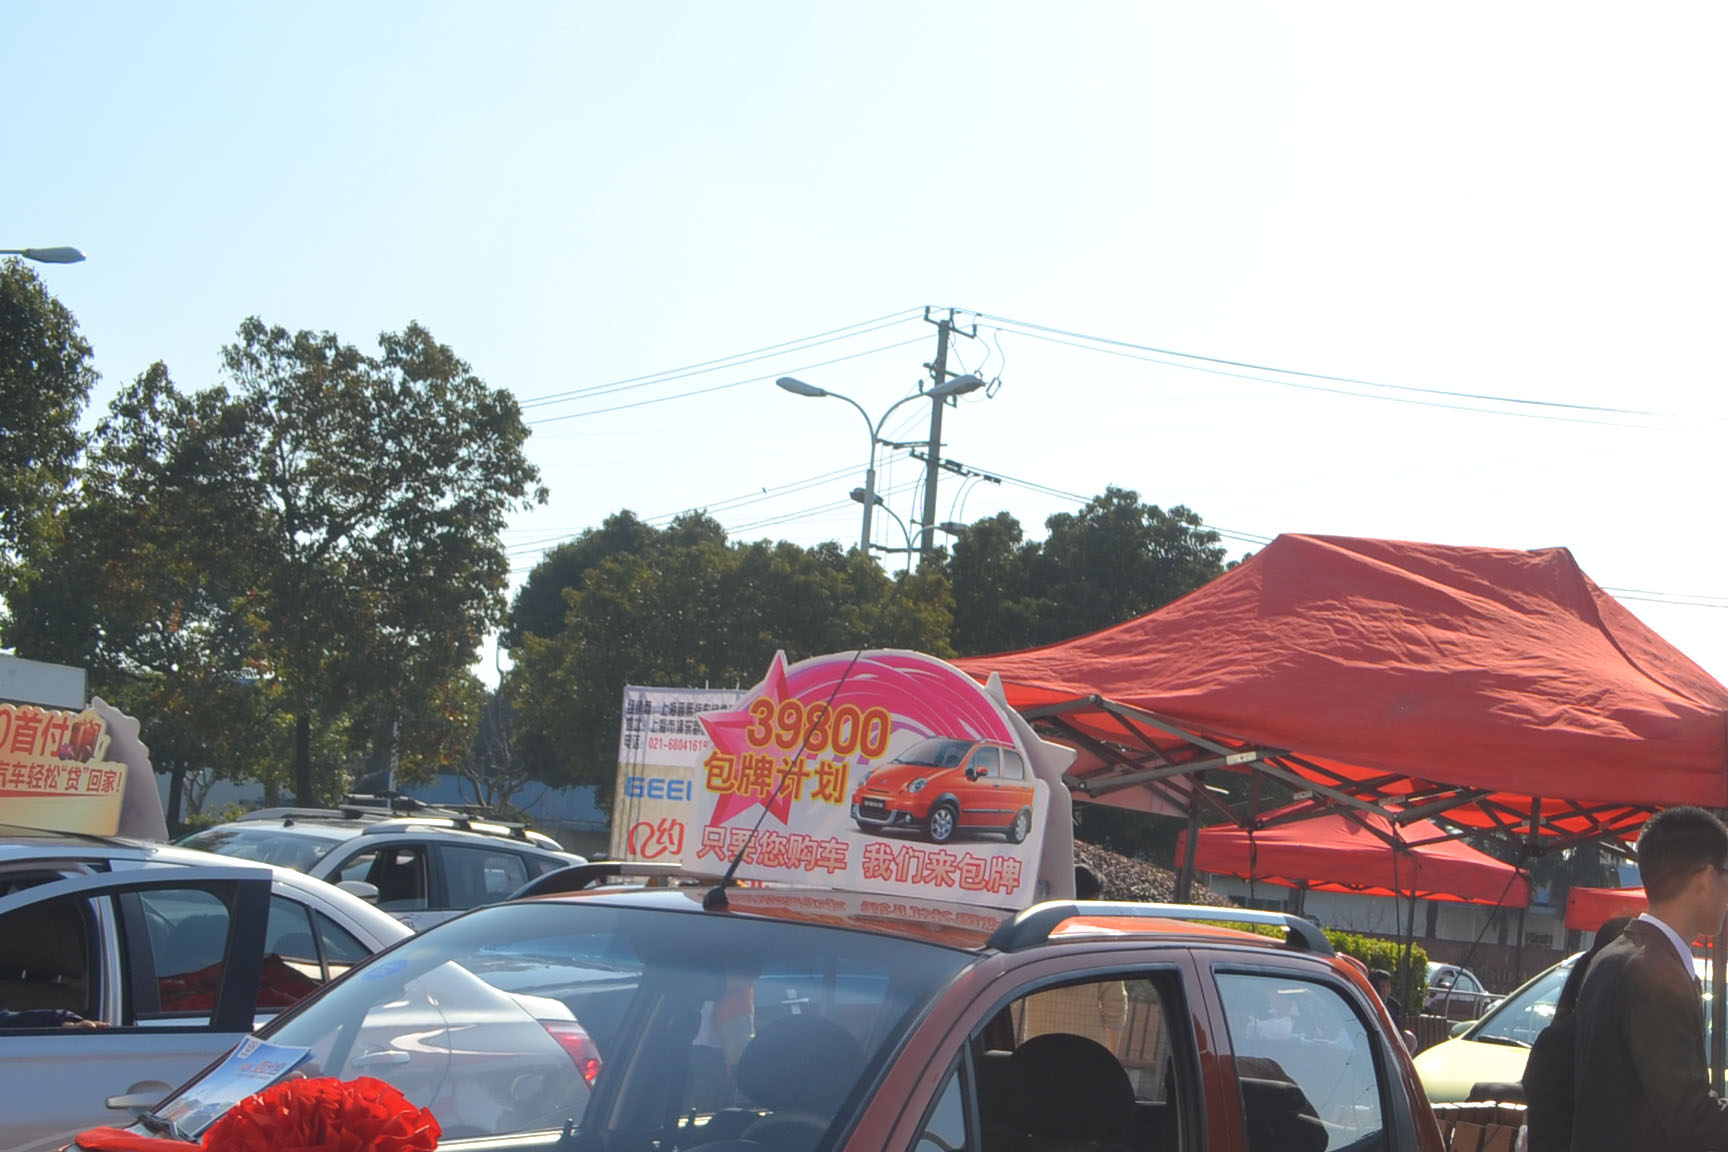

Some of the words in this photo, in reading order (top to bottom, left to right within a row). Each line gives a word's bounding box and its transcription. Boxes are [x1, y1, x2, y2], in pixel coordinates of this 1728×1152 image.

[746, 697, 892, 758] 39800
[704, 750, 850, 804] 包牌计划
[697, 825, 849, 874] 只要您购车
[862, 841, 1023, 894] 我们来包牌
